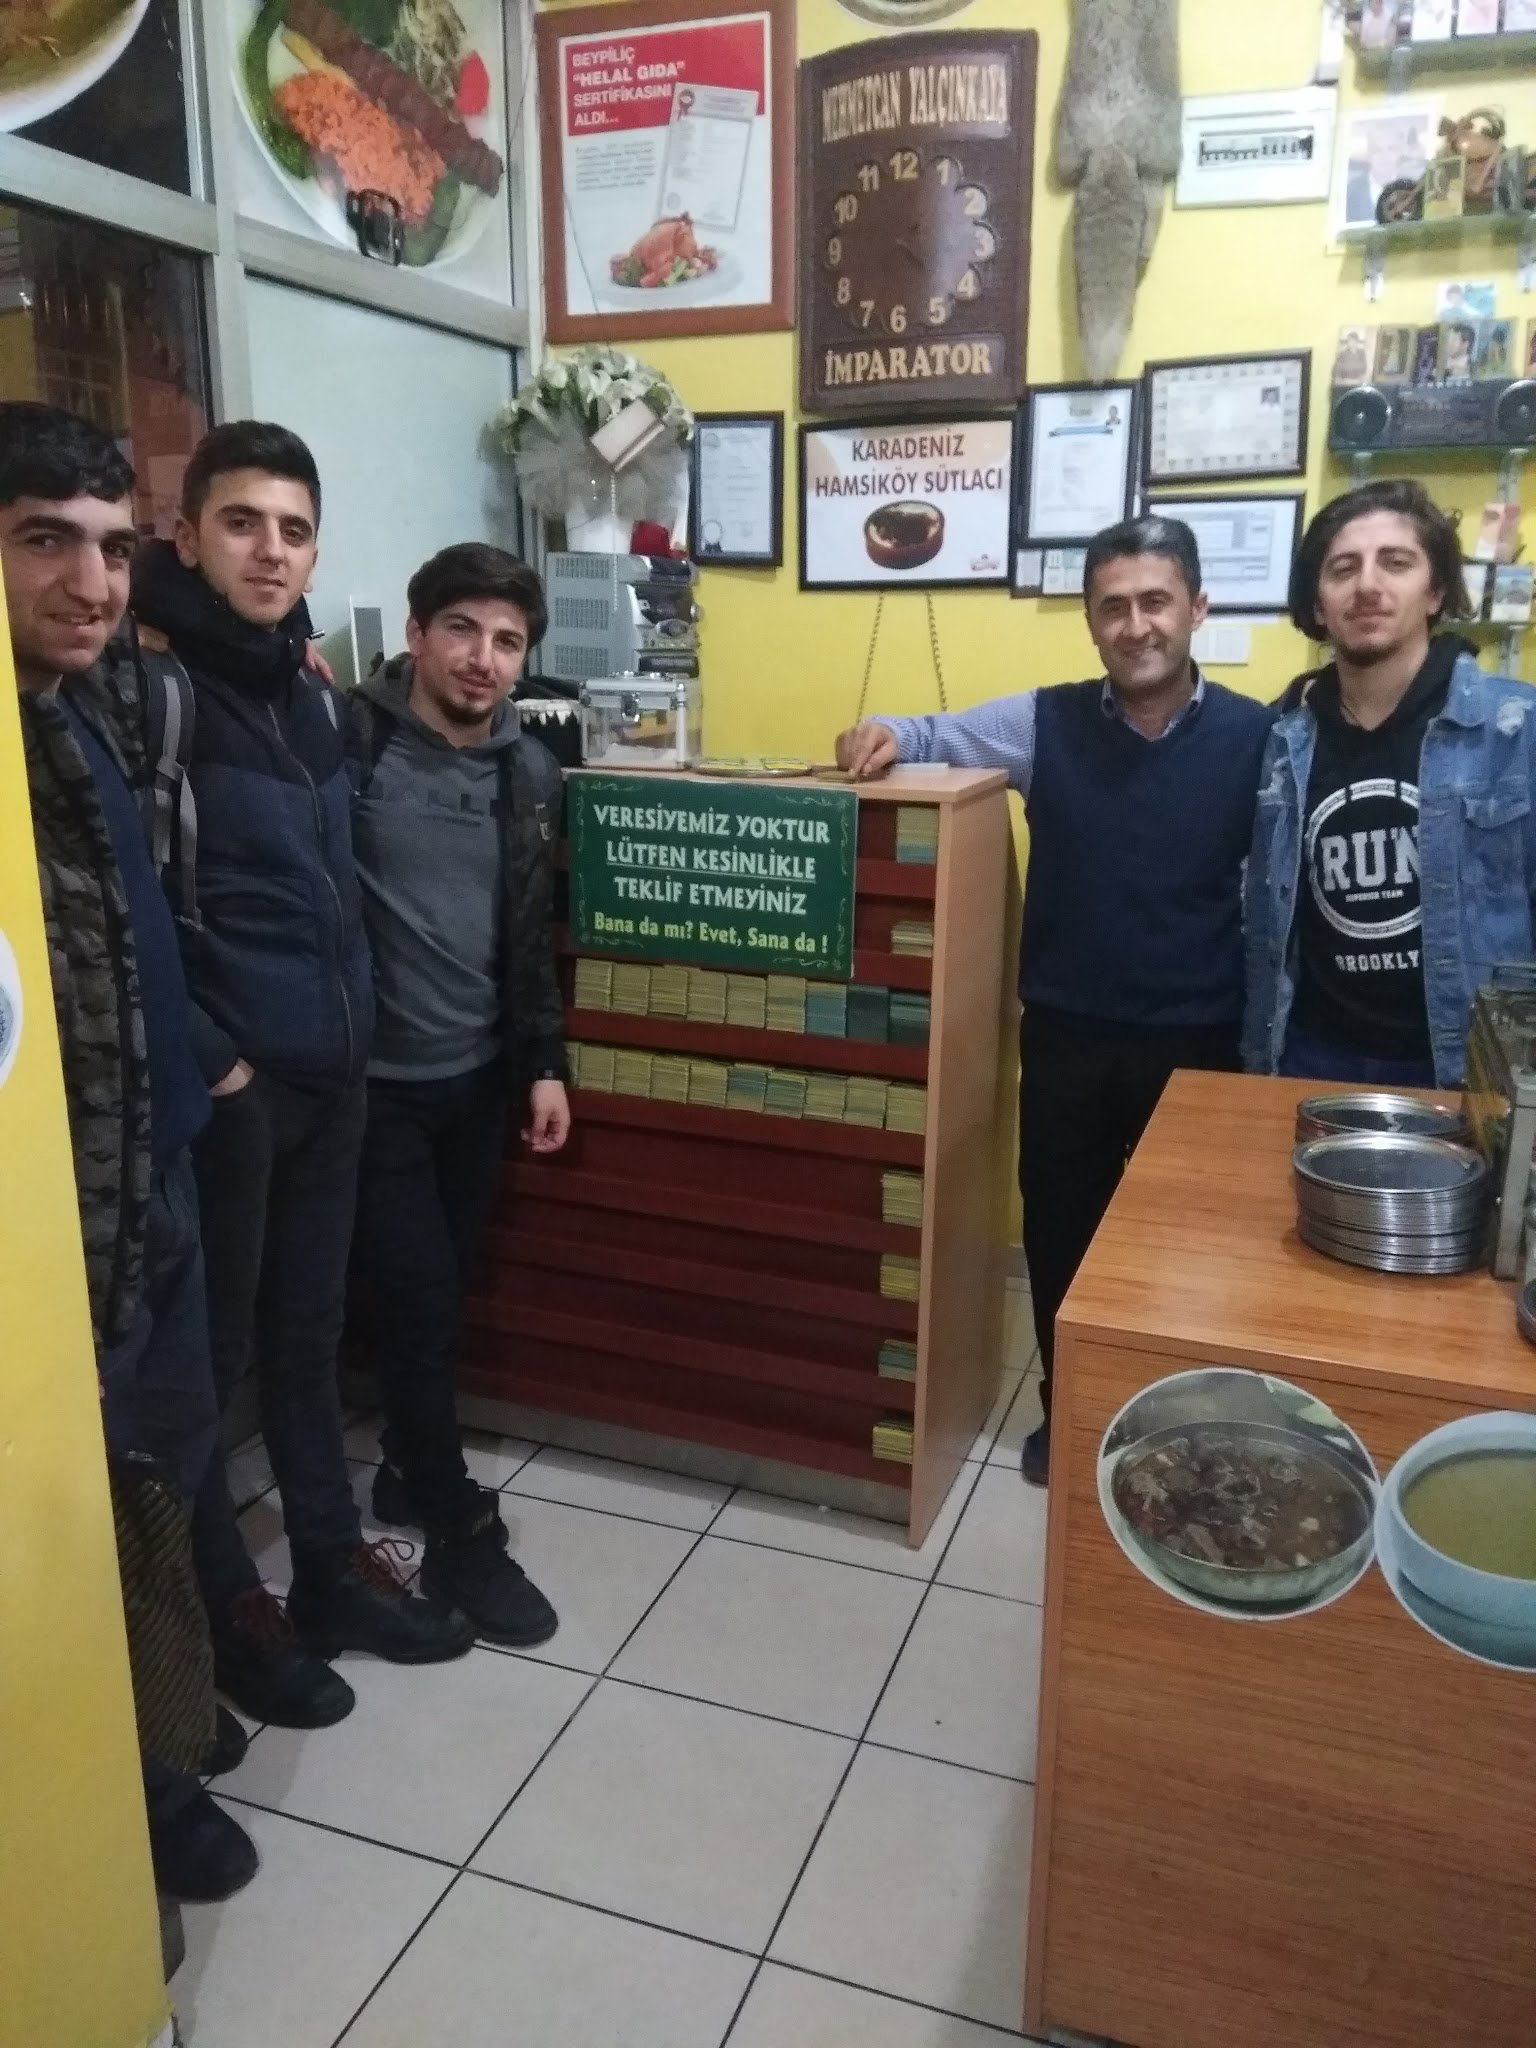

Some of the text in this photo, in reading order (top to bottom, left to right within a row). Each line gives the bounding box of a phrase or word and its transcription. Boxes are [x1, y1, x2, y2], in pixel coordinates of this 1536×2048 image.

[572, 46, 635, 66] BEYPİLİÇ
[574, 84, 671, 107] SERTİFİKASINI
[859, 166, 880, 191] 11
[890, 151, 919, 180] 12
[936, 160, 951, 185] 1
[835, 194, 858, 224] 10
[963, 187, 987, 215] 2
[828, 238, 842, 265] 9
[974, 232, 995, 259] 3
[837, 277, 851, 303] 8
[957, 272, 975, 298] 4
[860, 300, 874, 327] 7
[890, 306, 906, 332] 6
[929, 298, 947, 323] 5
[824, 343, 991, 385] İMPARATOR
[852, 429, 965, 462] KARADENİZ
[815, 464, 1002, 497] HAMSİKÖY SÜTLACI
[593, 803, 830, 844] VERESİYEMİZ YOKTUR
[606, 836, 817, 880] LÜTFEN KESİNLİKLE
[613, 875, 807, 916] TEKLİF ETMEYİNİZ
[594, 911, 634, 934] Bana
[638, 915, 659, 937] da
[664, 920, 693, 940] mı?
[699, 921, 742, 948] Evet,
[747, 927, 789, 950] Sana
[794, 931, 816, 953] da
